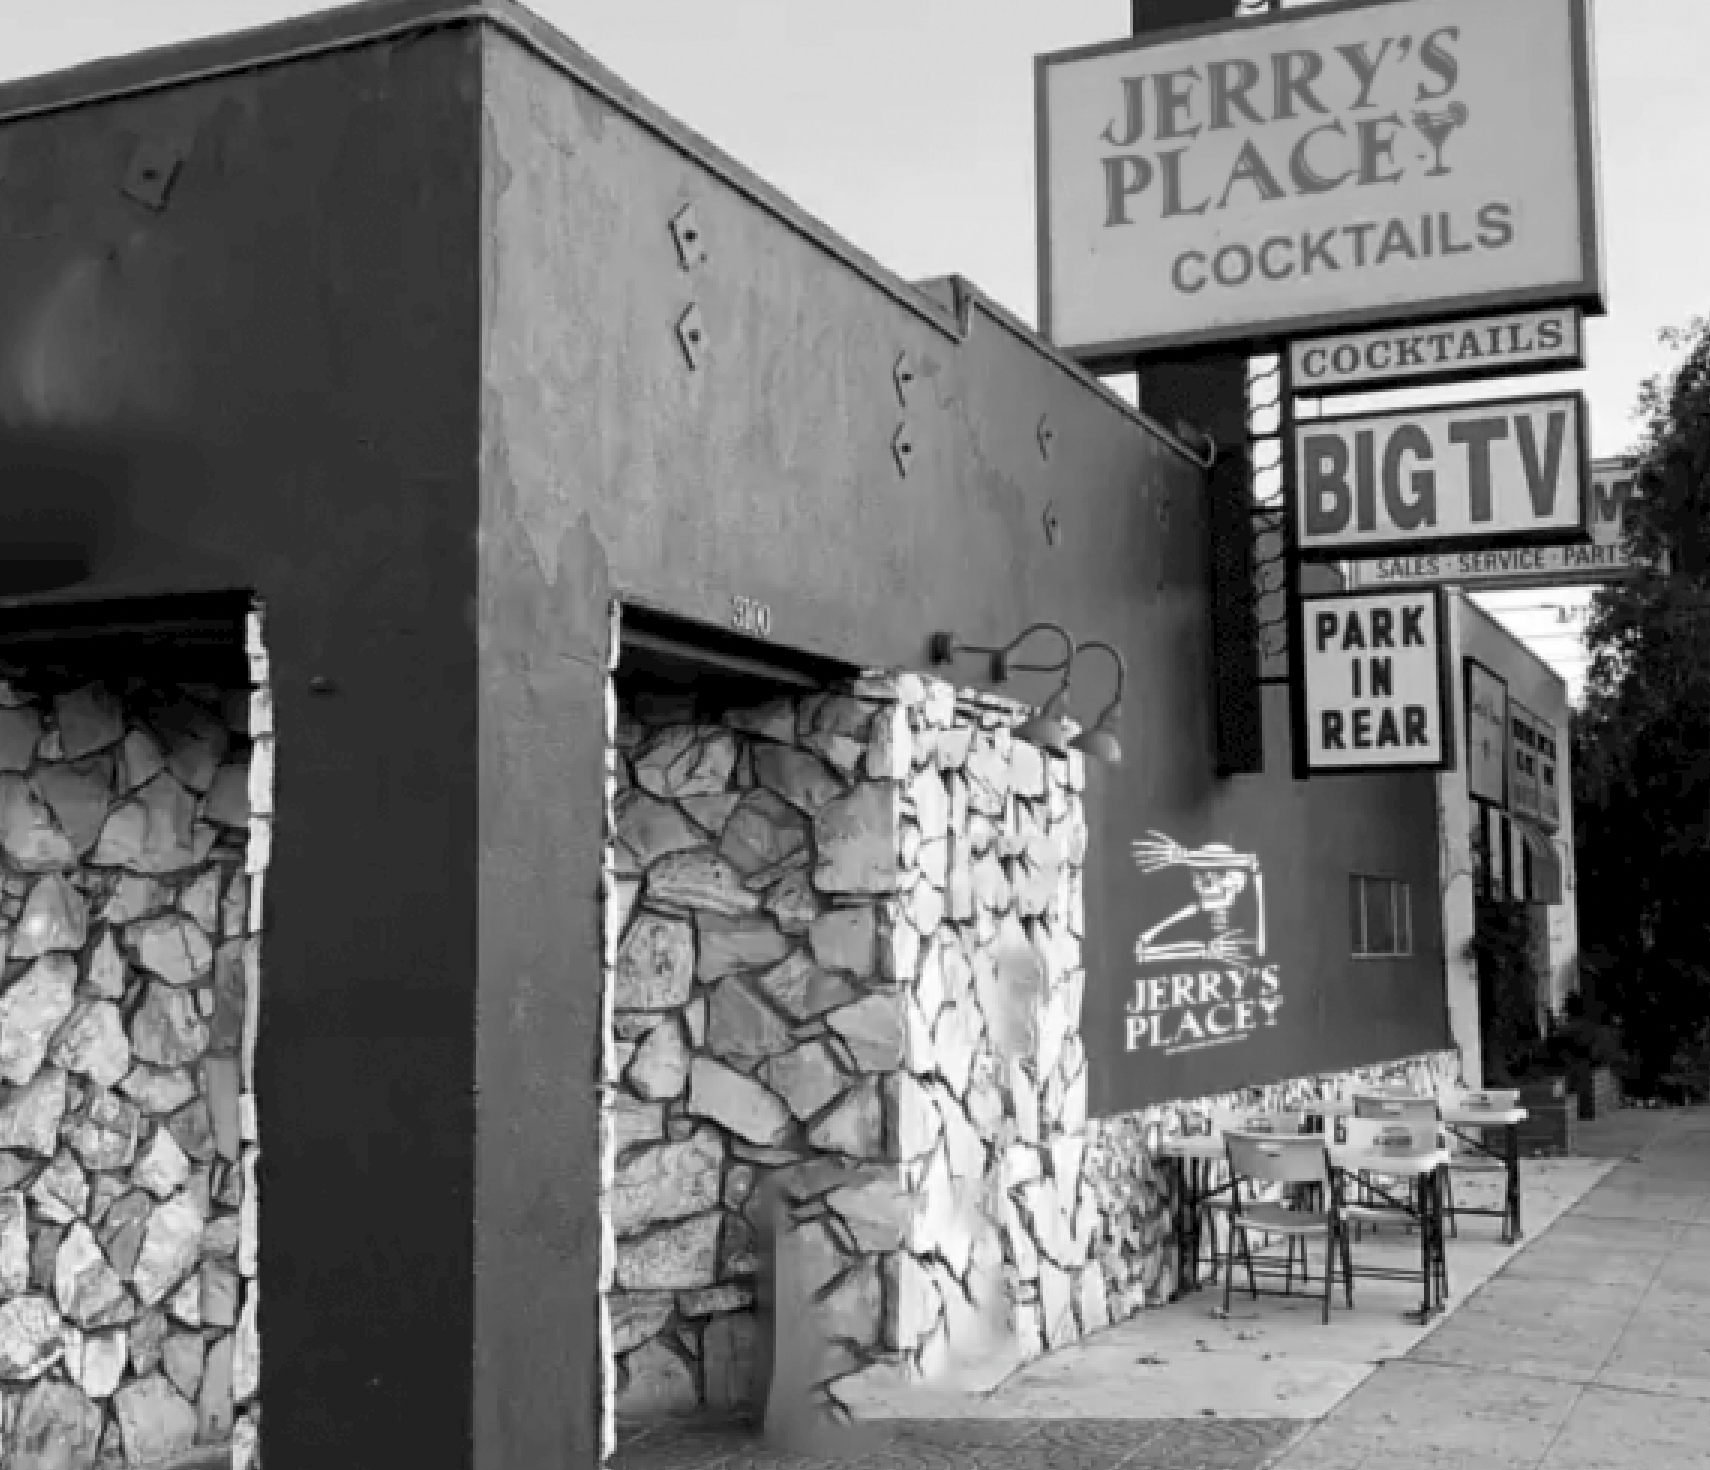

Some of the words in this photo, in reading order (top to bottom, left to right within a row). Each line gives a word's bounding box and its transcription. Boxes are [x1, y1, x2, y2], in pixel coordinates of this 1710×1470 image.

[1100, 25, 1460, 146] JERRY'S
[1170, 201, 1513, 294] COCKTAILS
[1301, 318, 1564, 378] COCKTAILS
[1303, 423, 1437, 537] BIG
[1448, 410, 1567, 523] TV
[1375, 557, 1440, 580] SALES
[1456, 547, 1546, 573] SERVICE
[1315, 605, 1425, 653] PARK
[1351, 655, 1393, 699] IN
[1320, 703, 1430, 750] REAR
[1124, 962, 1281, 1014] JERRY'S
